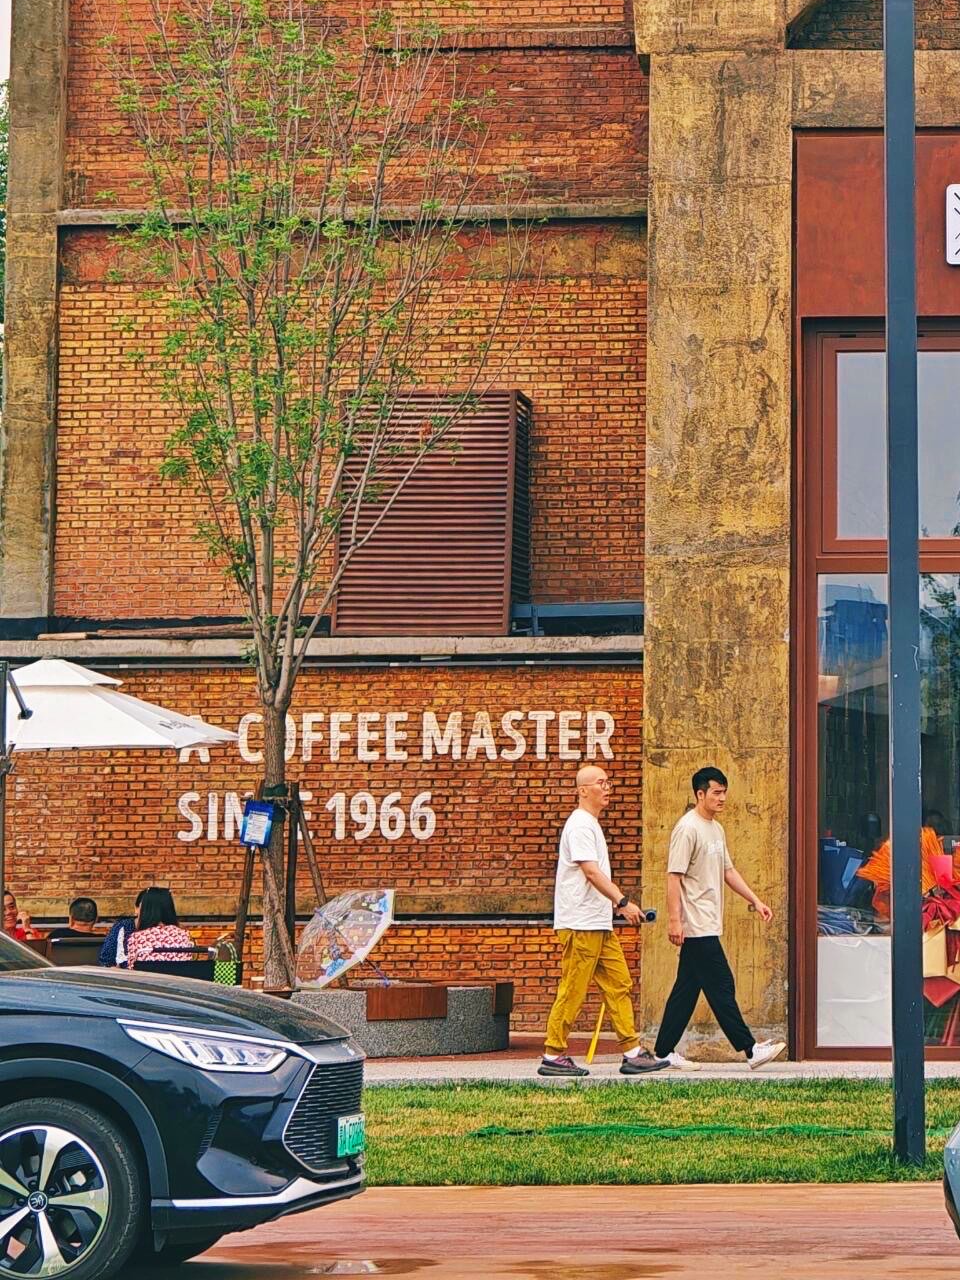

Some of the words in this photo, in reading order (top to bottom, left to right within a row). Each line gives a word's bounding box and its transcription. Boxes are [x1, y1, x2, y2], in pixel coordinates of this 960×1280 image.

[422, 711, 615, 761] MASTER
[177, 791, 314, 842] SINE
[326, 792, 436, 842] 1966
